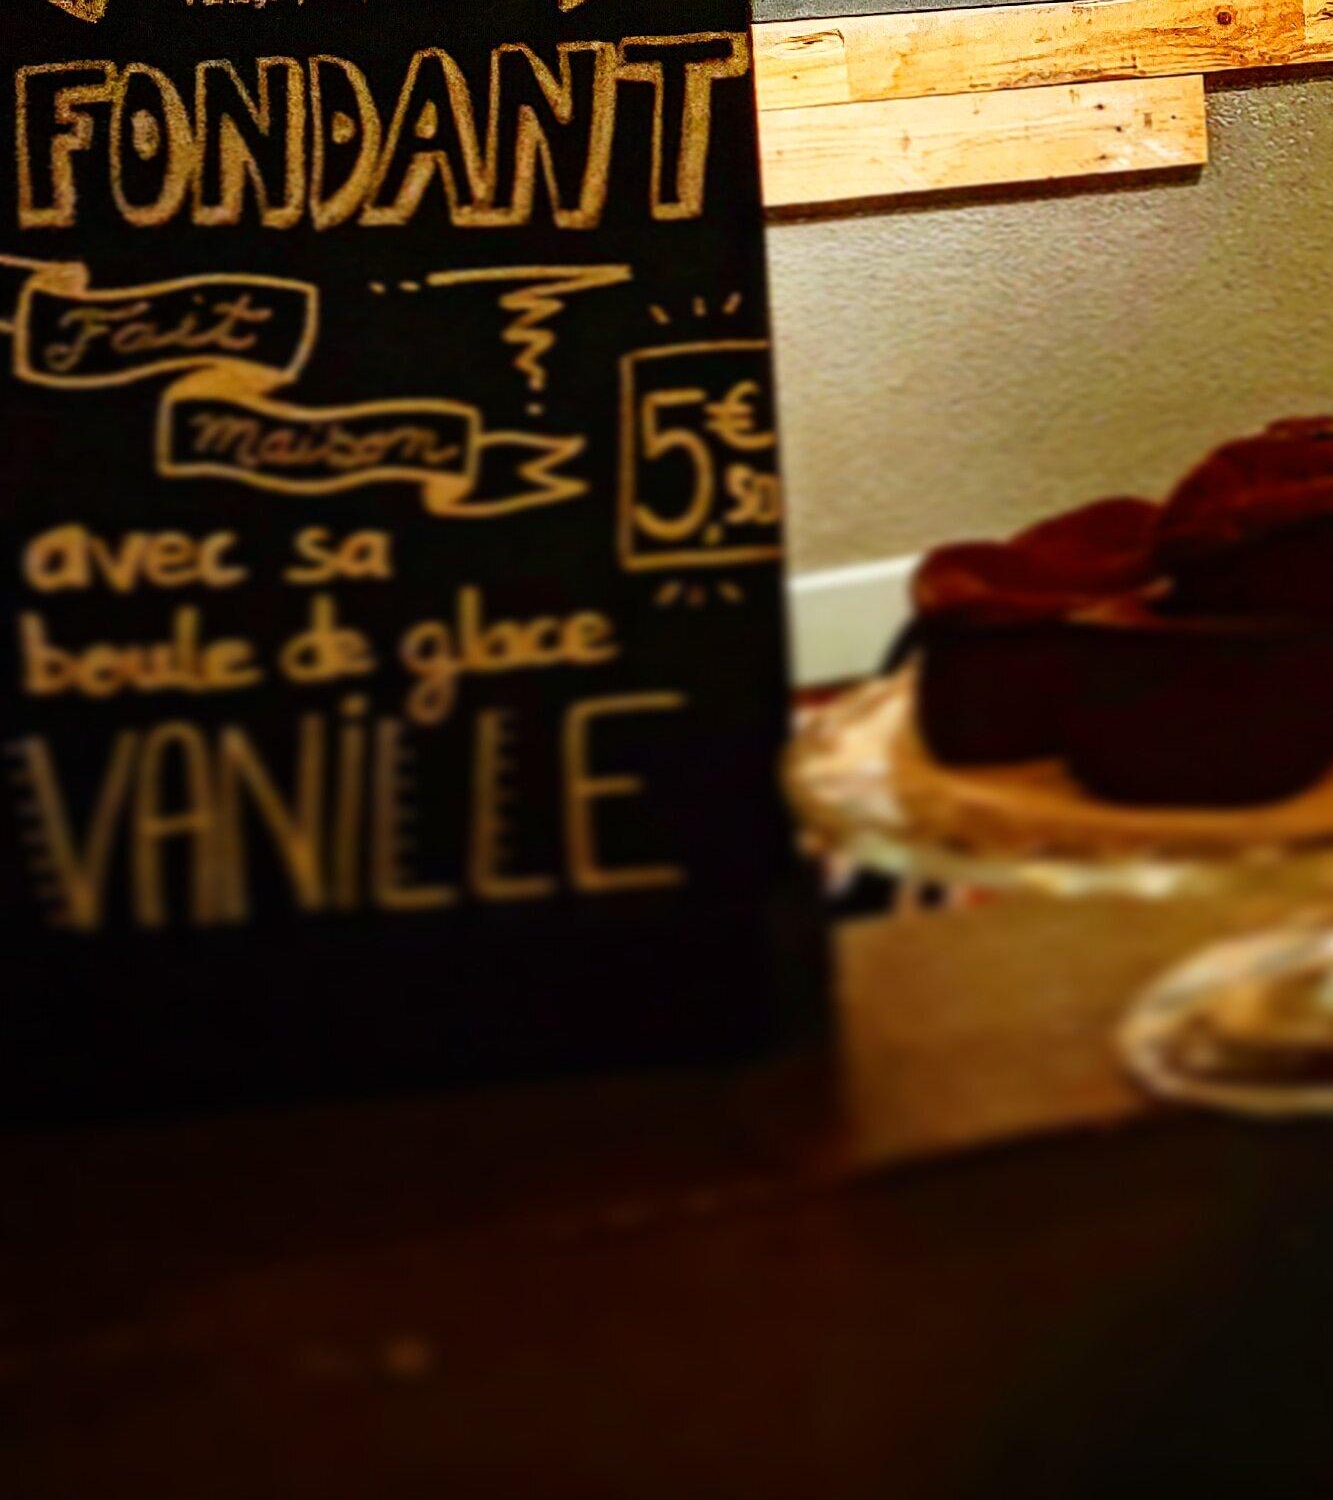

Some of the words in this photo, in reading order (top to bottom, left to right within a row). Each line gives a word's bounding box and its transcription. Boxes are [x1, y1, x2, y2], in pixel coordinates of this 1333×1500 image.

[14, 30, 749, 232] FONDANT
[44, 292, 274, 371] Fait
[24, 523, 247, 592] avec
[283, 526, 394, 585] sa
[19, 605, 262, 695] boule
[279, 592, 378, 681] de
[400, 586, 621, 724] glace
